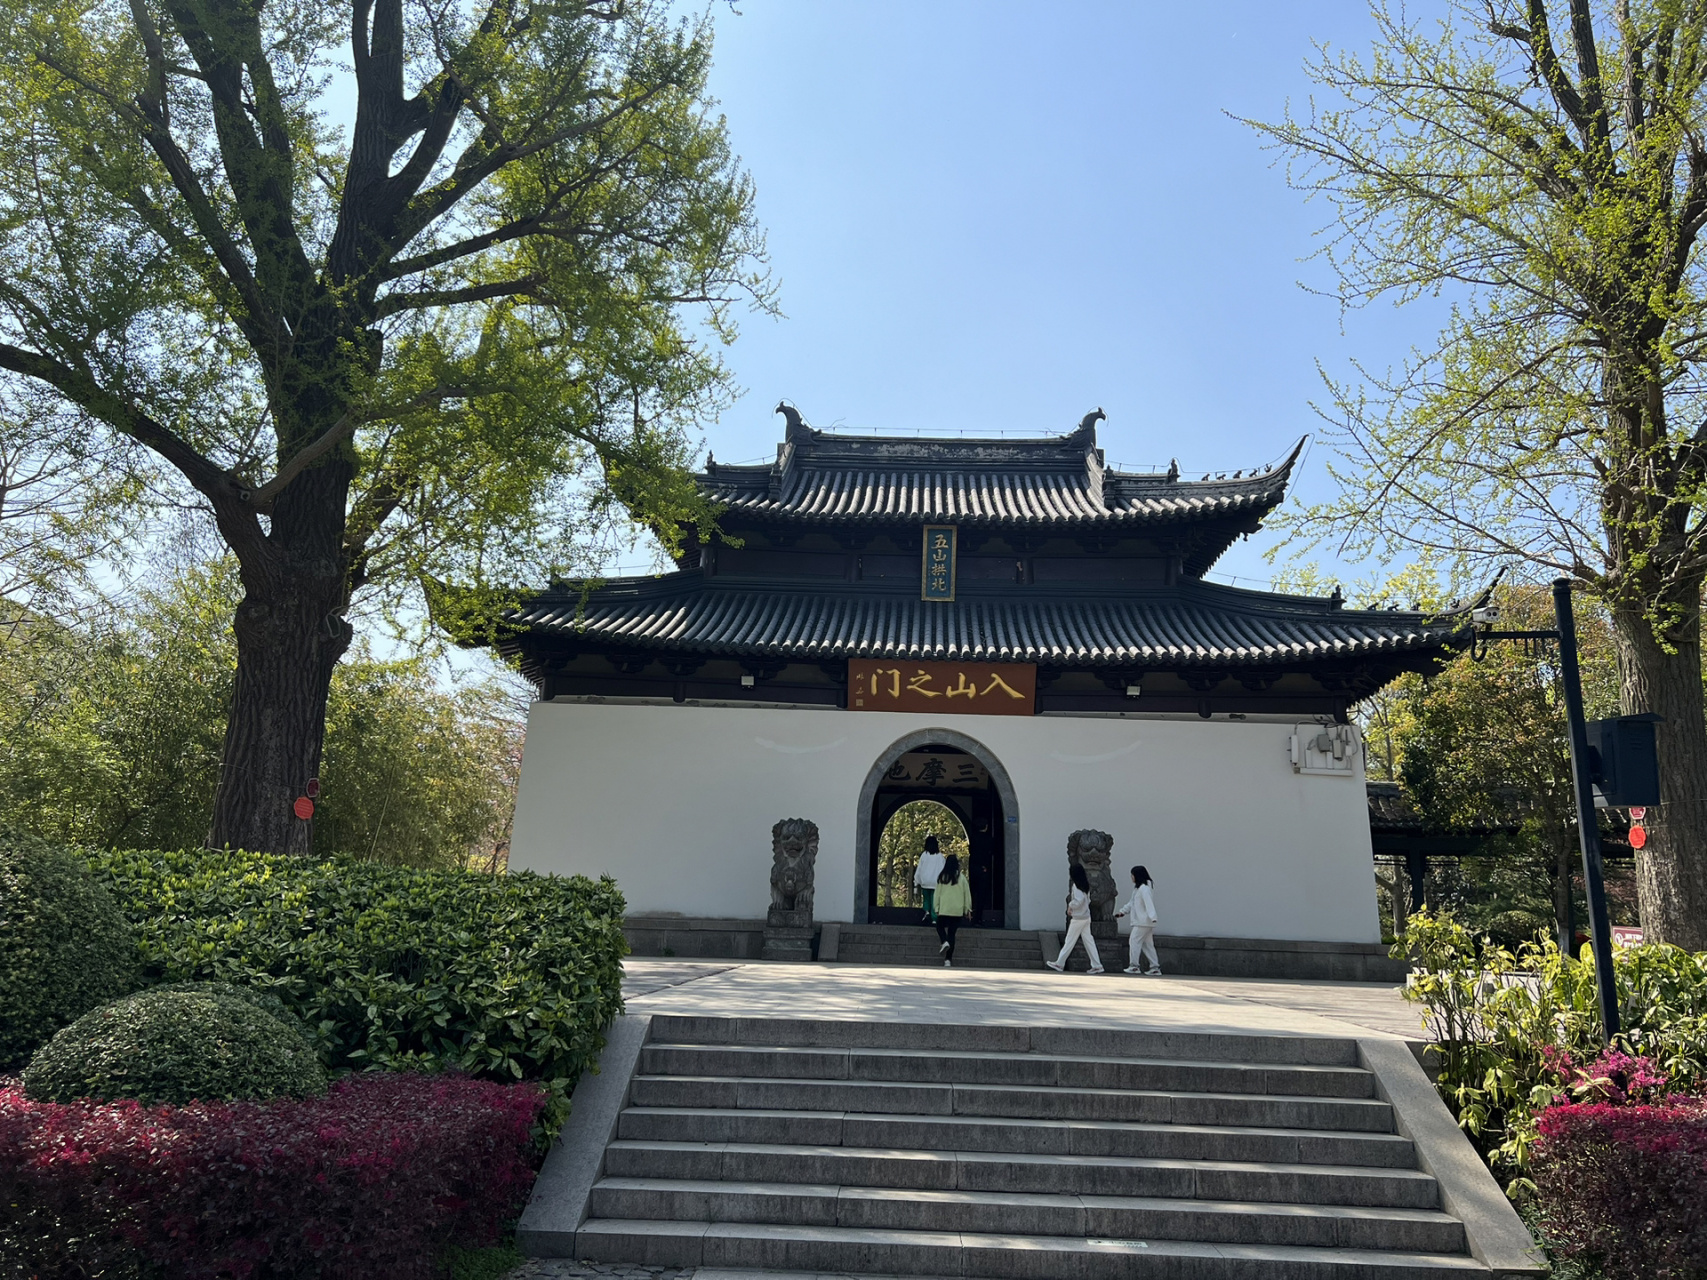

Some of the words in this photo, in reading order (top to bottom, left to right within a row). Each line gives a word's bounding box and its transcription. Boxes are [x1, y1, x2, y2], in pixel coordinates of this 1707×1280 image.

[931, 534, 949, 591] 五山拱北
[870, 668, 1026, 699] 入山之门
